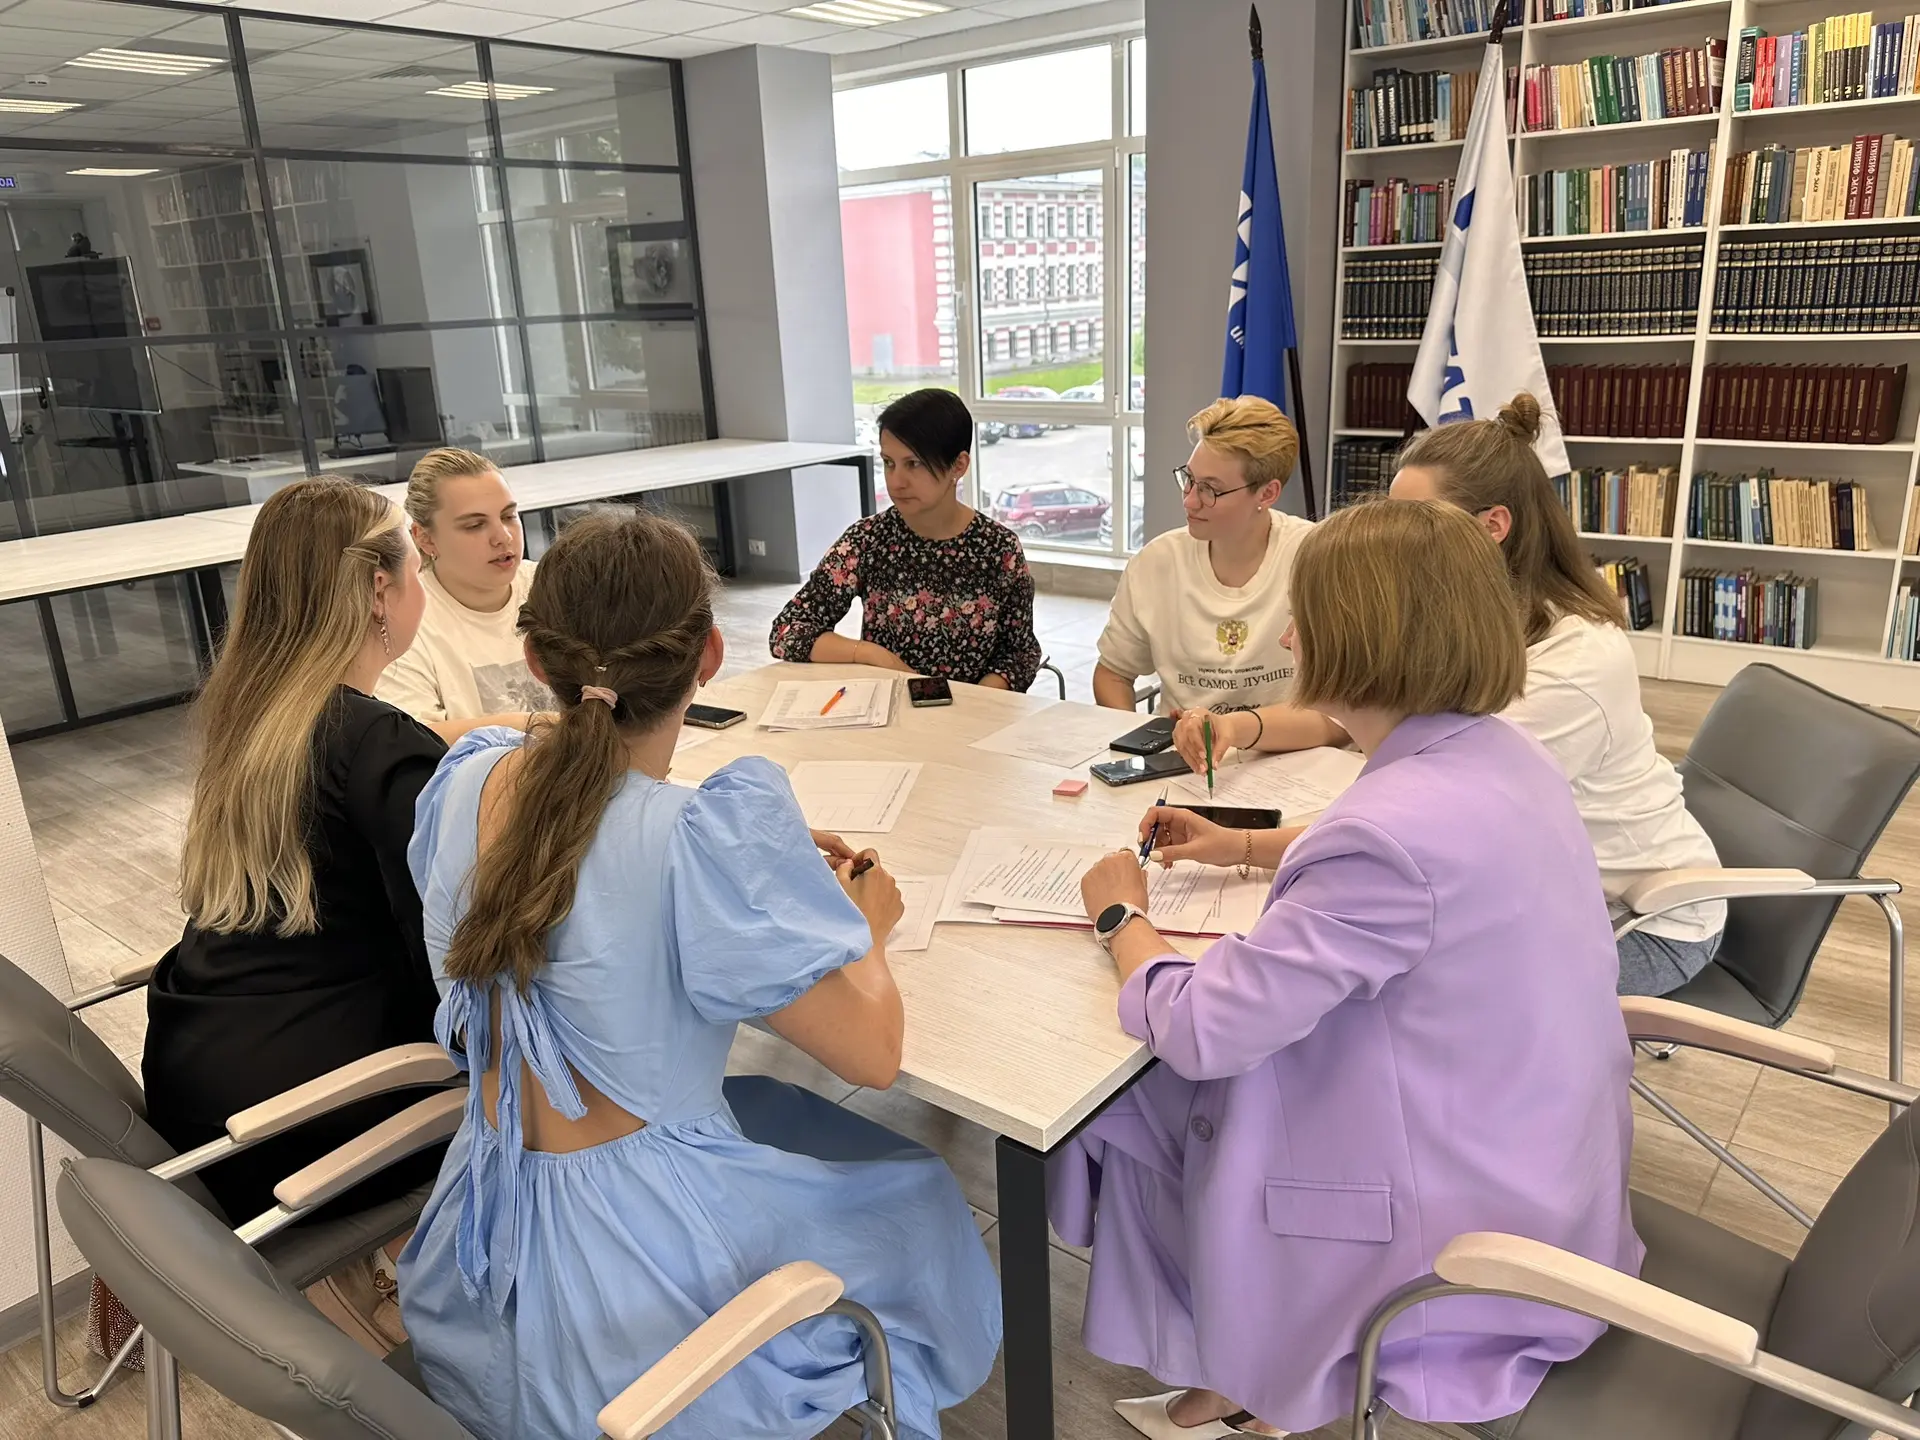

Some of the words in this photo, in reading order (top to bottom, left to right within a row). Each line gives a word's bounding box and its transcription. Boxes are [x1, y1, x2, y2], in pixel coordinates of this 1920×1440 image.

[1854, 144, 1863, 174] ФИЗИКИ
[1868, 143, 1879, 173] ФИЗИКИ
[1850, 176, 1861, 195] КУРС
[1865, 176, 1874, 194] КУРС
[1198, 677, 1238, 690] САМОЕ
